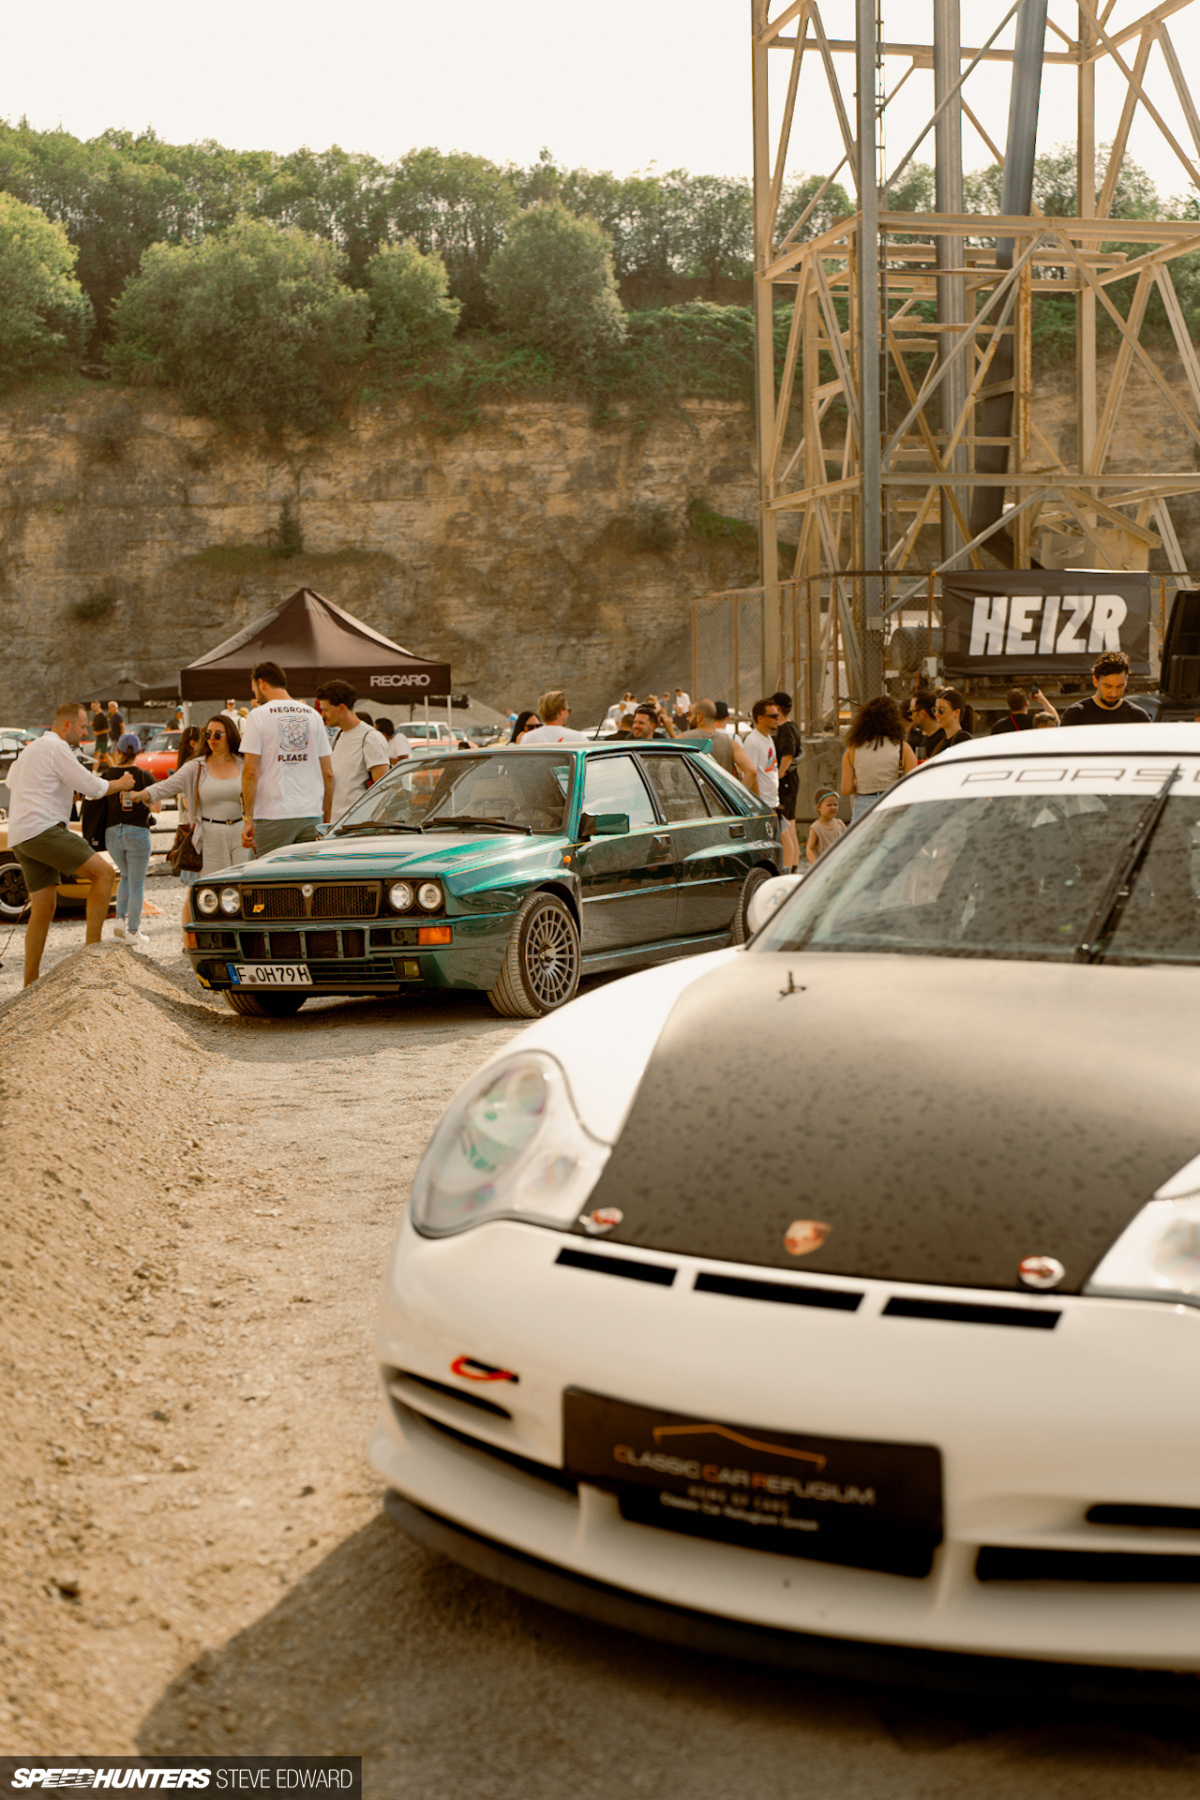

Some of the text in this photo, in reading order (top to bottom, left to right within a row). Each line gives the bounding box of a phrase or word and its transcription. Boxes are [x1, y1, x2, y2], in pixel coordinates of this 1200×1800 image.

[969, 594, 1128, 656] HEIZR
[370, 674, 431, 687] RECARO
[269, 706, 312, 714] NEGRONI
[277, 753, 309, 762] PLEASE
[960, 767, 1200, 787] PORS
[236, 966, 246, 982] F
[614, 1444, 876, 1506] CLASSIC CAR REFUGIUM
